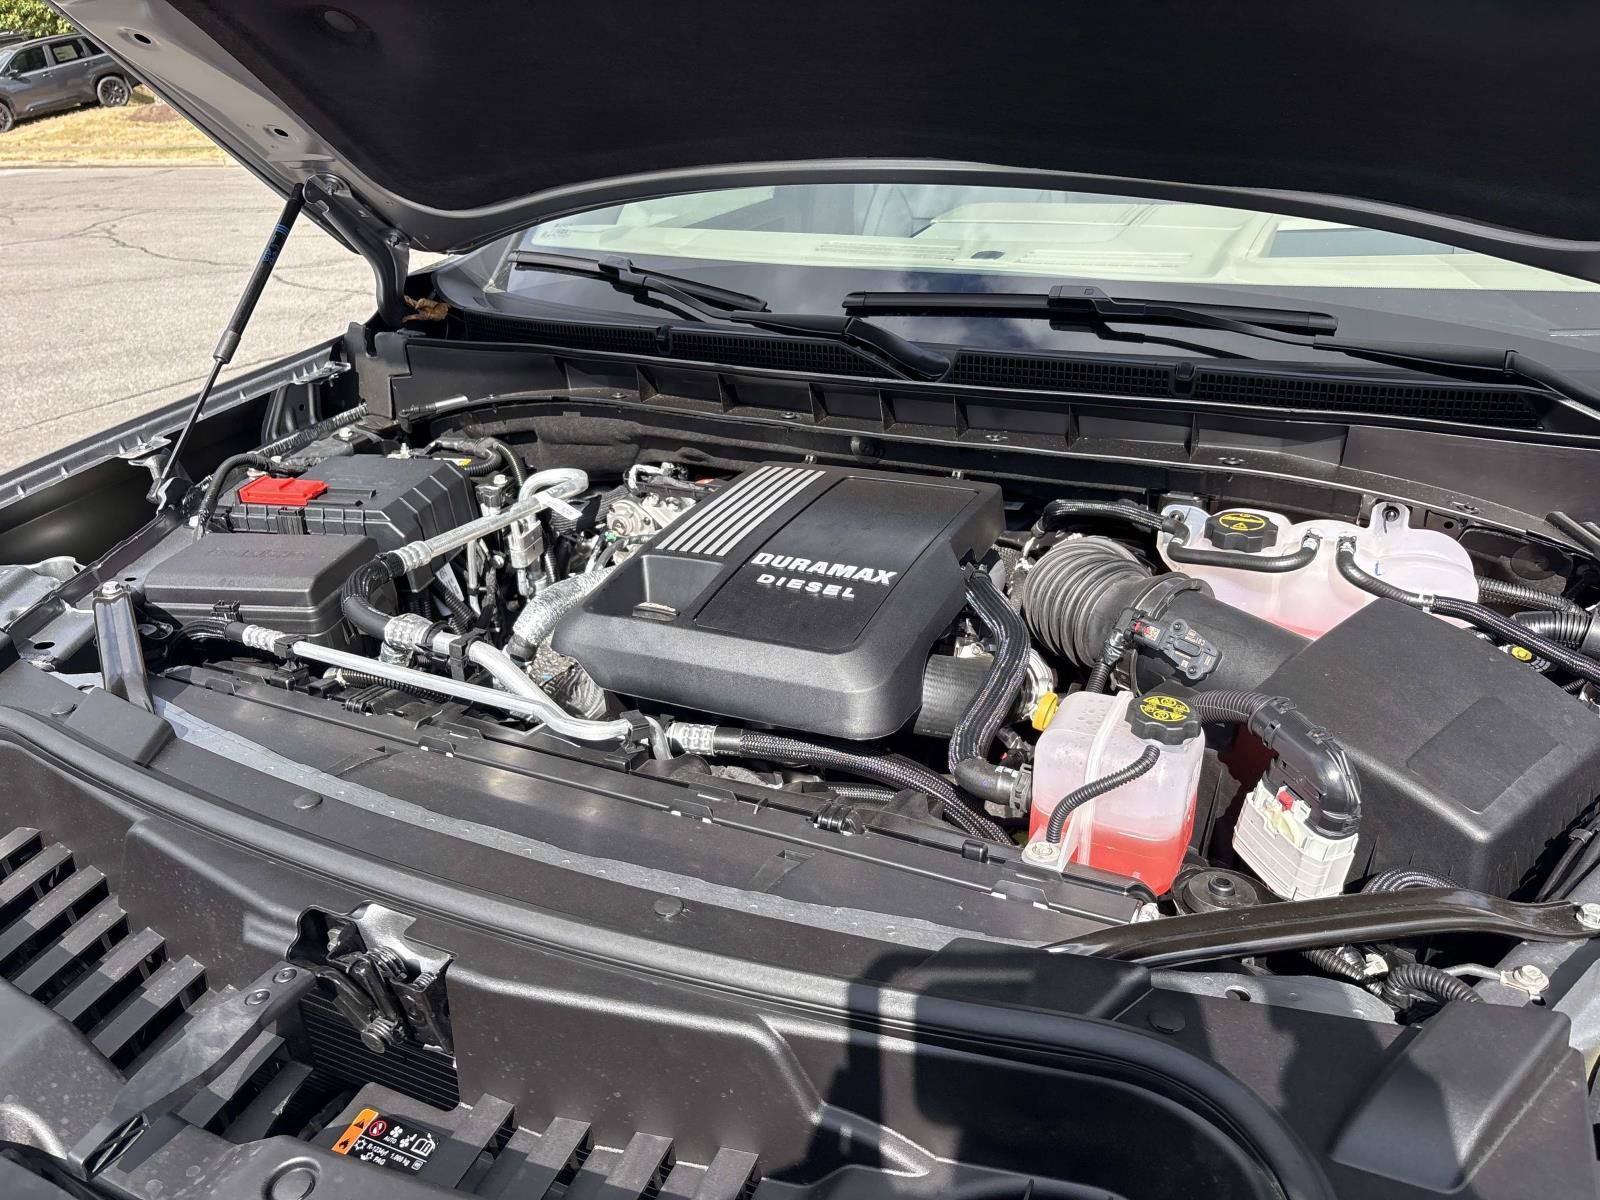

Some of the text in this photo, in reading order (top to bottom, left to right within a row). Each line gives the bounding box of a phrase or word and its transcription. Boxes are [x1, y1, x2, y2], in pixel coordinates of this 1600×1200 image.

[750, 552, 898, 585] DURAMAX
[756, 573, 855, 599] DIESEL
[383, 1136, 397, 1144] AUTO
